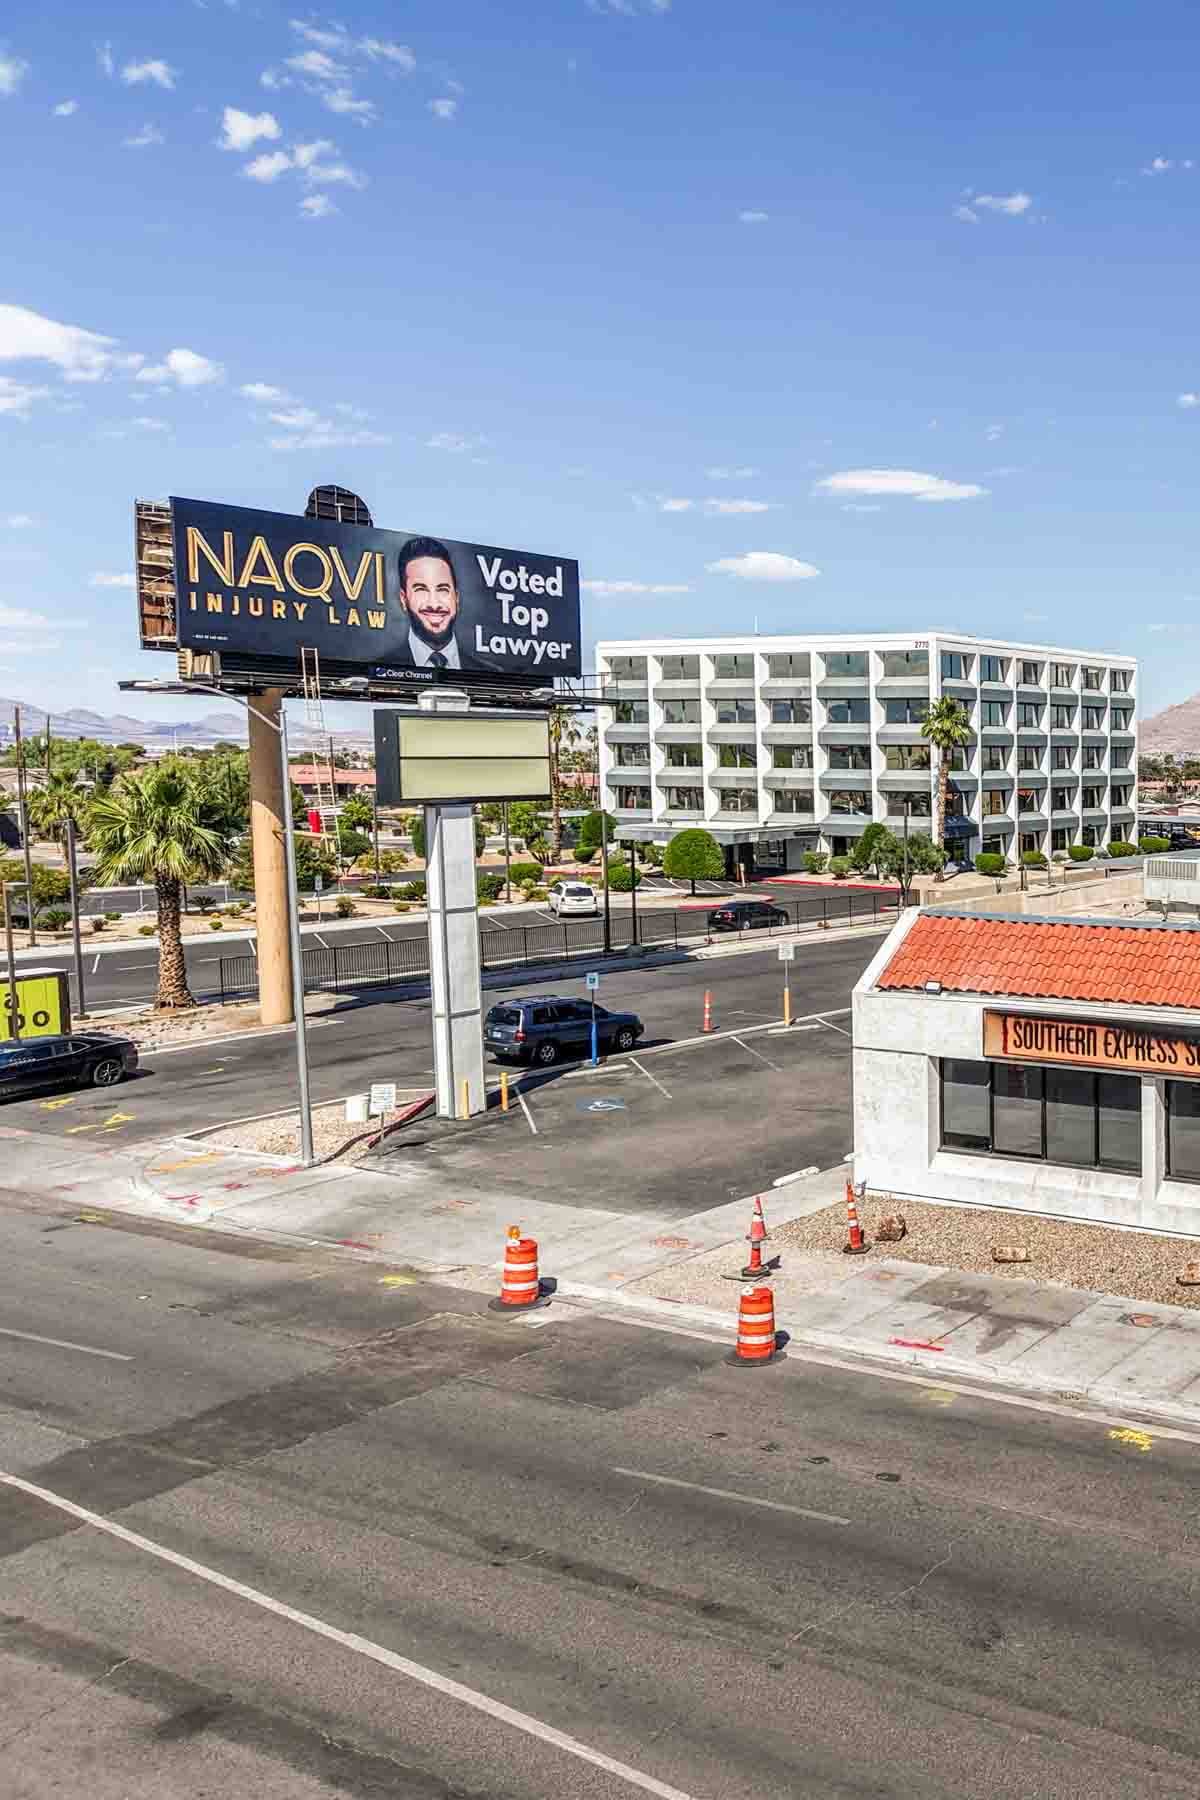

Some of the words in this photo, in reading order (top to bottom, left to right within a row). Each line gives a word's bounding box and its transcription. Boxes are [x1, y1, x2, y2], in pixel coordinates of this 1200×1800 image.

[186, 526, 385, 604] NAQVI
[476, 554, 563, 597] Voted
[189, 591, 308, 621] INJURY
[328, 606, 385, 629] LAW
[496, 592, 549, 636] Top
[475, 624, 572, 665] Lawyer
[386, 669, 405, 678] Clear
[405, 670, 433, 680] Channel
[1012, 1020, 1097, 1055] SOUTHERN
[1103, 1028, 1178, 1065] EXPRESS
